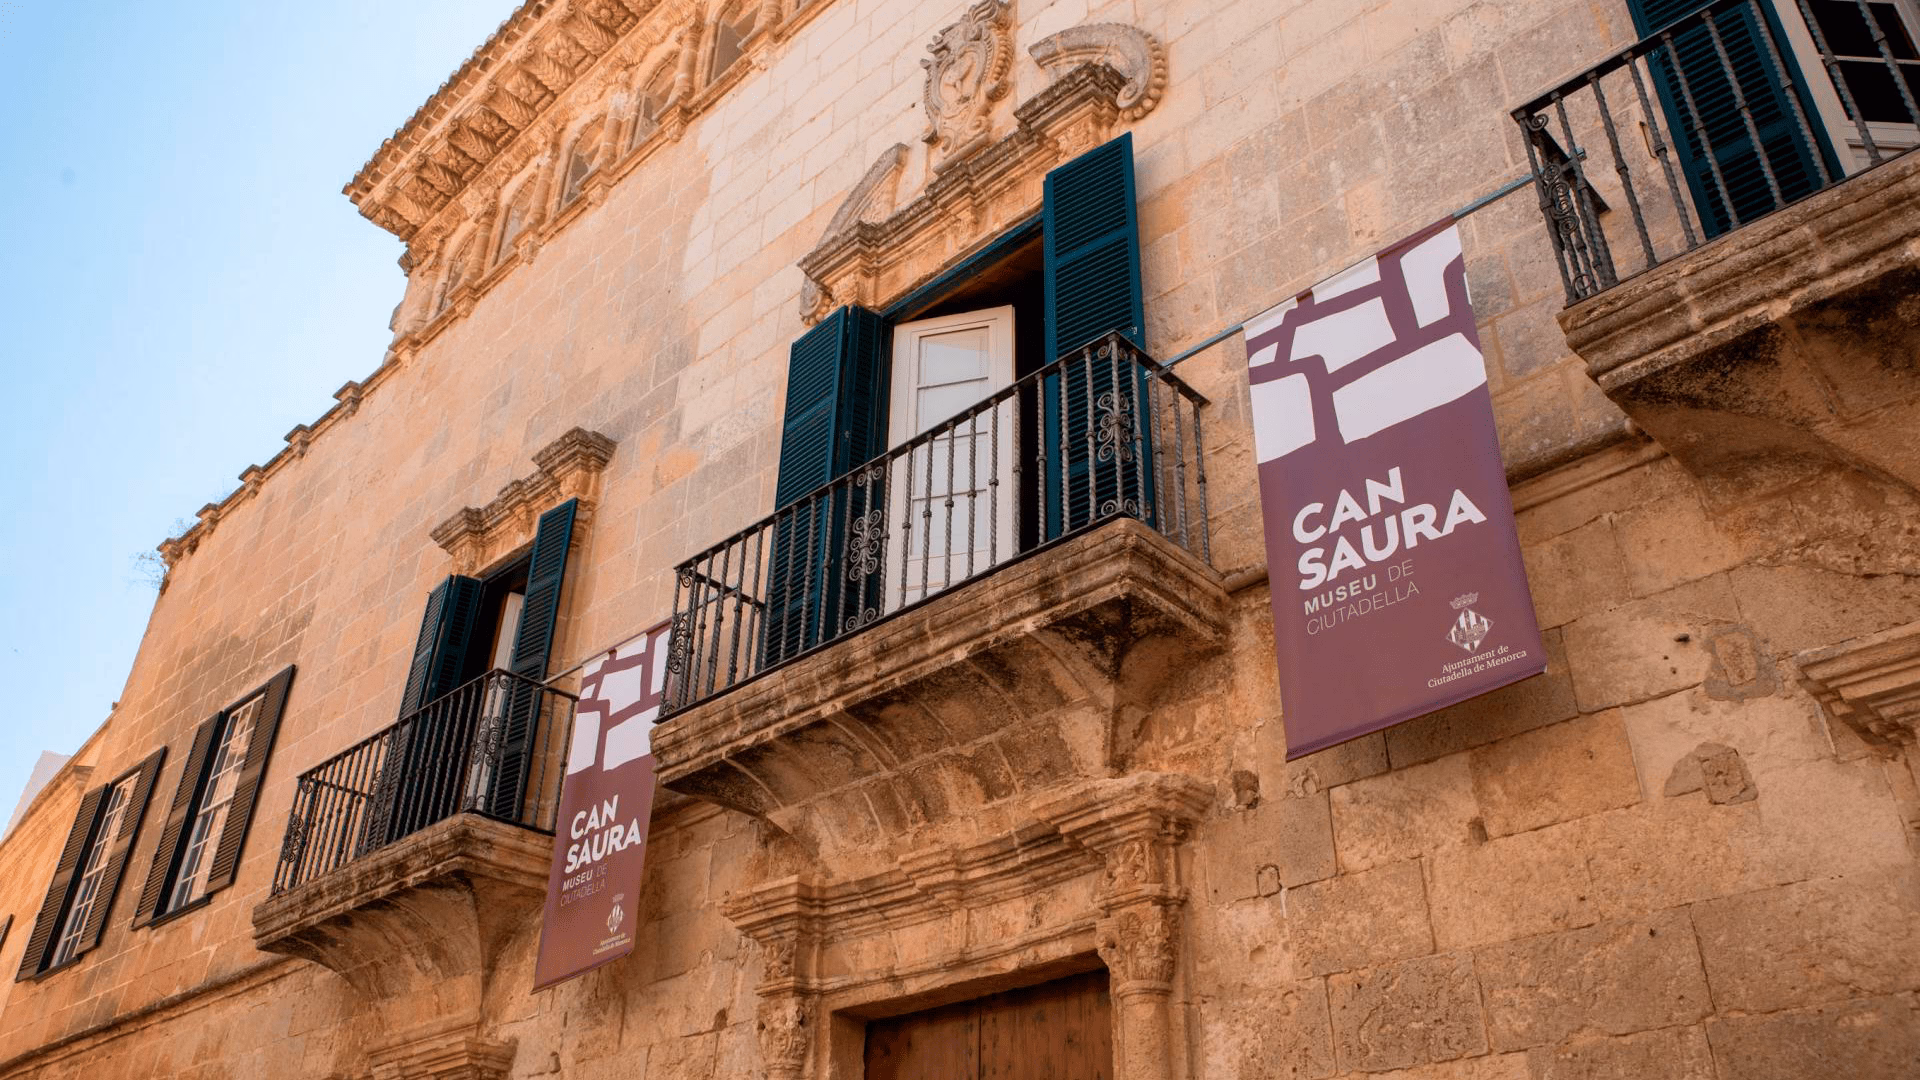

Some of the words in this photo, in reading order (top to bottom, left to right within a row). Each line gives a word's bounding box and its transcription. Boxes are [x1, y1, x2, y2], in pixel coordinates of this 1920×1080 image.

[1293, 466, 1405, 544] CAN
[1298, 488, 1487, 590] SAURA
[1304, 574, 1377, 615] MUSEU
[1388, 559, 1414, 582] DE
[1306, 581, 1420, 635] CIUTADELLA
[1427, 668, 1472, 688] Ciutadella
[1473, 663, 1485, 673] de
[1486, 650, 1527, 669] Menorca
[1442, 650, 1495, 674] Ajuntament
[1497, 645, 1509, 655] de
[570, 794, 619, 840] CAN
[564, 818, 641, 874] SAURA
[560, 878, 605, 907] CIUTADELLA
[562, 869, 593, 891] MUSEU
[596, 863, 608, 877] DE
